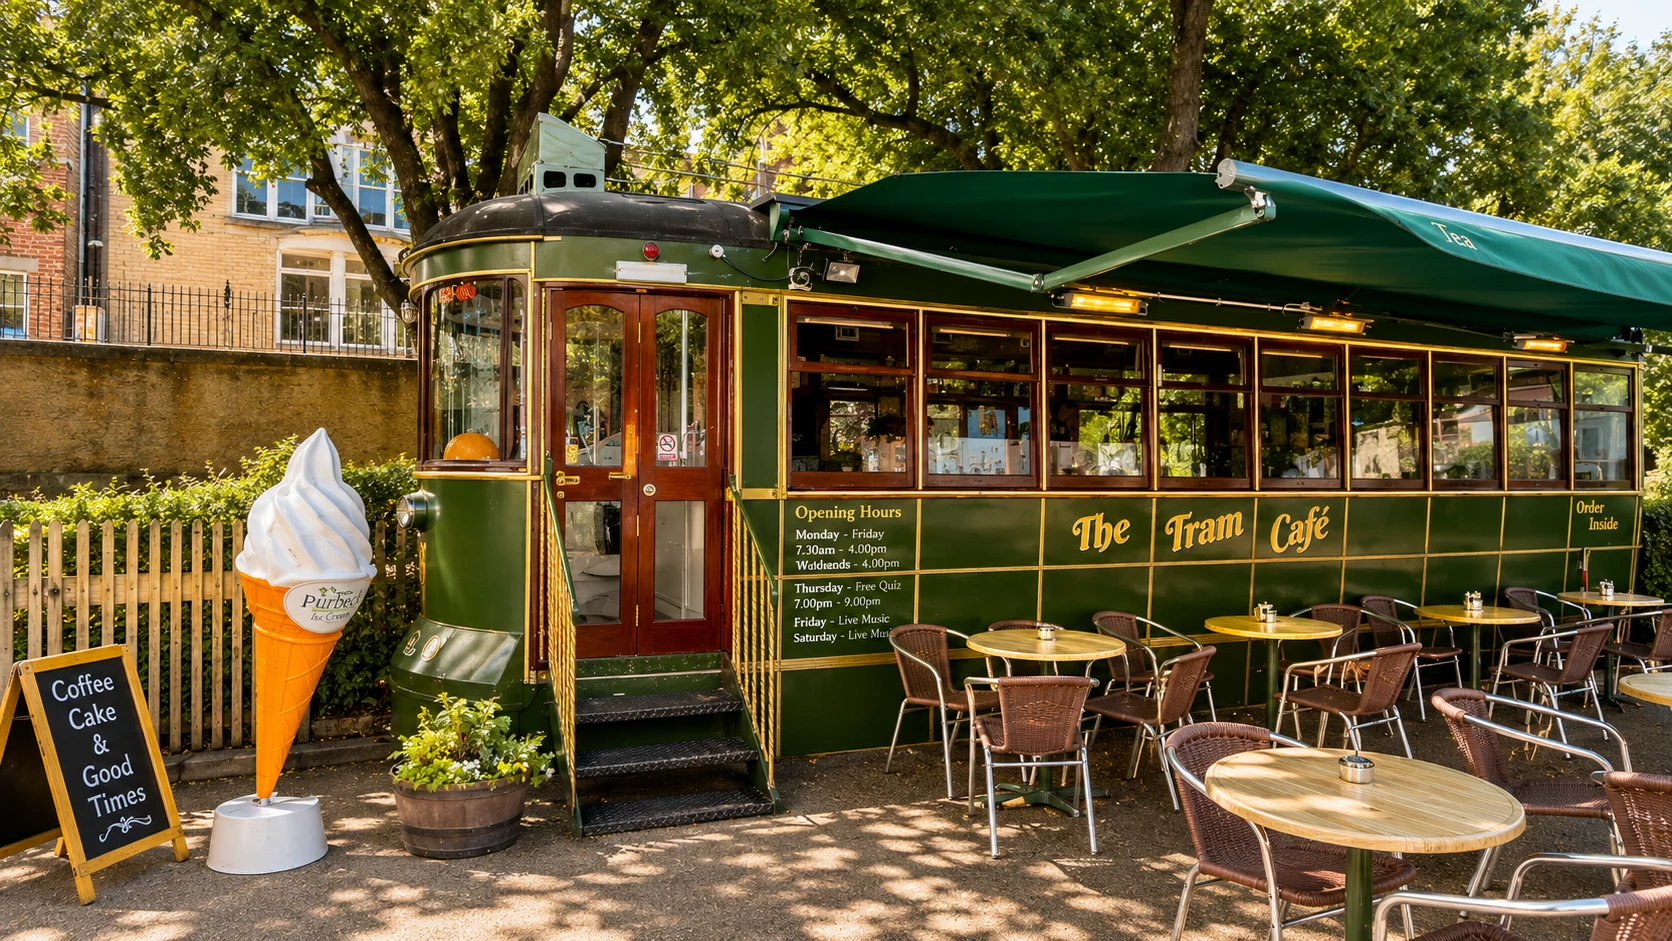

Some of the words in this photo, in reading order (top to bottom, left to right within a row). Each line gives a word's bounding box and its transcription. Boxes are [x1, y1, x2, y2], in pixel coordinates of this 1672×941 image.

[1431, 221, 1478, 250] Tea
[795, 505, 855, 522] Opening
[860, 505, 902, 518] Hours
[1576, 500, 1605, 514] Order
[1072, 512, 1131, 553] The
[1165, 511, 1244, 553] Tram
[1270, 505, 1330, 554] Café
[1588, 516, 1619, 531] Inside
[795, 529, 840, 542] Monday
[852, 529, 885, 541] Friday
[795, 545, 836, 556] 7.30am
[848, 544, 887, 556] 4.00pm
[861, 558, 900, 571] 4.00pm
[794, 582, 844, 595] Thursday
[855, 581, 876, 592] Free
[879, 580, 902, 593] Quiz
[794, 598, 833, 611] 7.00pm
[844, 596, 881, 609] 9.00pm
[794, 617, 827, 629] Friday
[838, 615, 859, 626] Live
[861, 613, 890, 625] Music
[793, 632, 838, 644] Saturday
[848, 629, 868, 640] Live
[51, 673, 115, 702] Coffee
[68, 703, 117, 730] Cake
[93, 733, 110, 755] &
[82, 753, 134, 788] Good
[87, 786, 147, 818] Times
